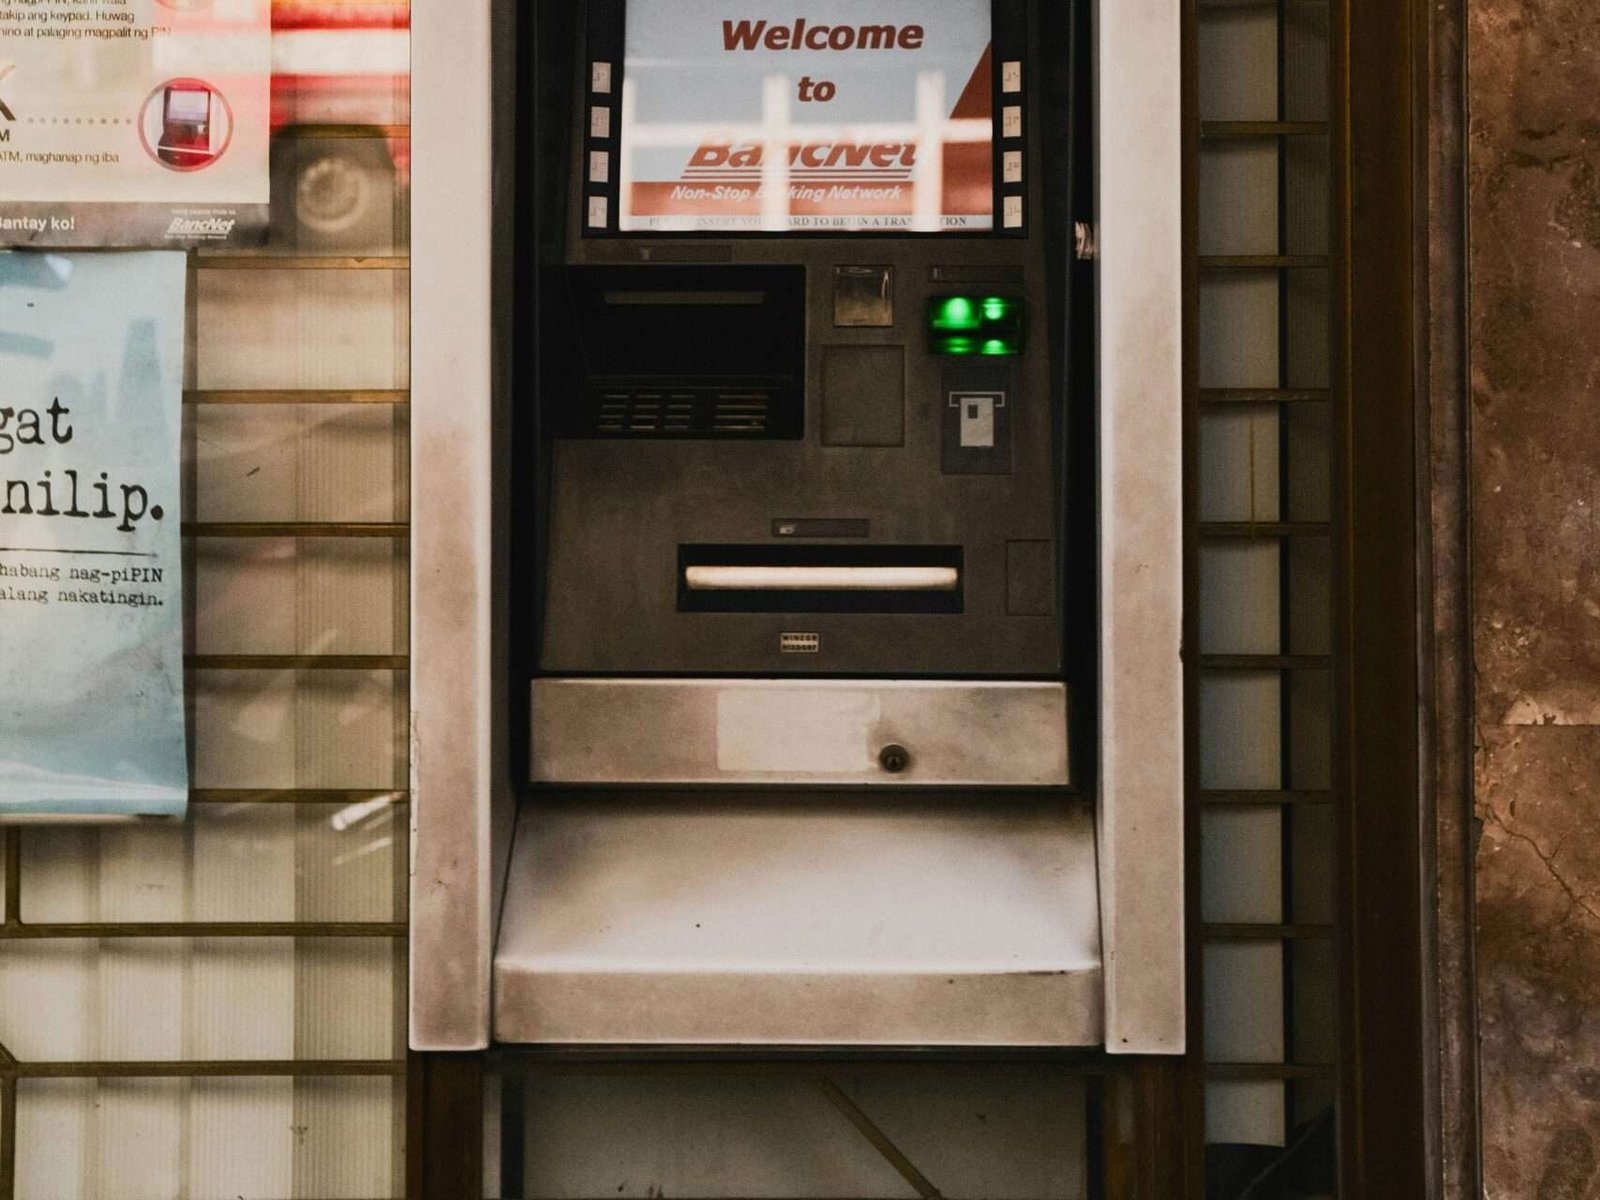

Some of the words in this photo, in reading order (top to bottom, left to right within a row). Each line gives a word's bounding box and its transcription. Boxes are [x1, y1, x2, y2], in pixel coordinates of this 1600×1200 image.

[96, 11, 134, 23] Huwag
[24, 28, 34, 36] at
[37, 27, 81, 38] palaging
[85, 27, 131, 38] magpalit
[135, 29, 148, 39] ng
[722, 19, 924, 50] Welcome
[798, 76, 836, 102] to
[26, 152, 82, 164] maghanap
[85, 154, 99, 164] ng
[102, 152, 119, 162] iba
[689, 141, 917, 167] BacNet
[671, 186, 750, 202] Non-Stop
[756, 186, 824, 202] Bking
[826, 185, 903, 200] Network
[51, 217, 75, 230] ko!
[788, 216, 809, 226] ARD
[814, 216, 829, 226] TO
[833, 216, 868, 226] BEIN
[871, 216, 880, 226] A
[1, 470, 164, 531] nilip.
[70, 567, 163, 584] nag-piPIN
[58, 589, 163, 607] nakatingin.
